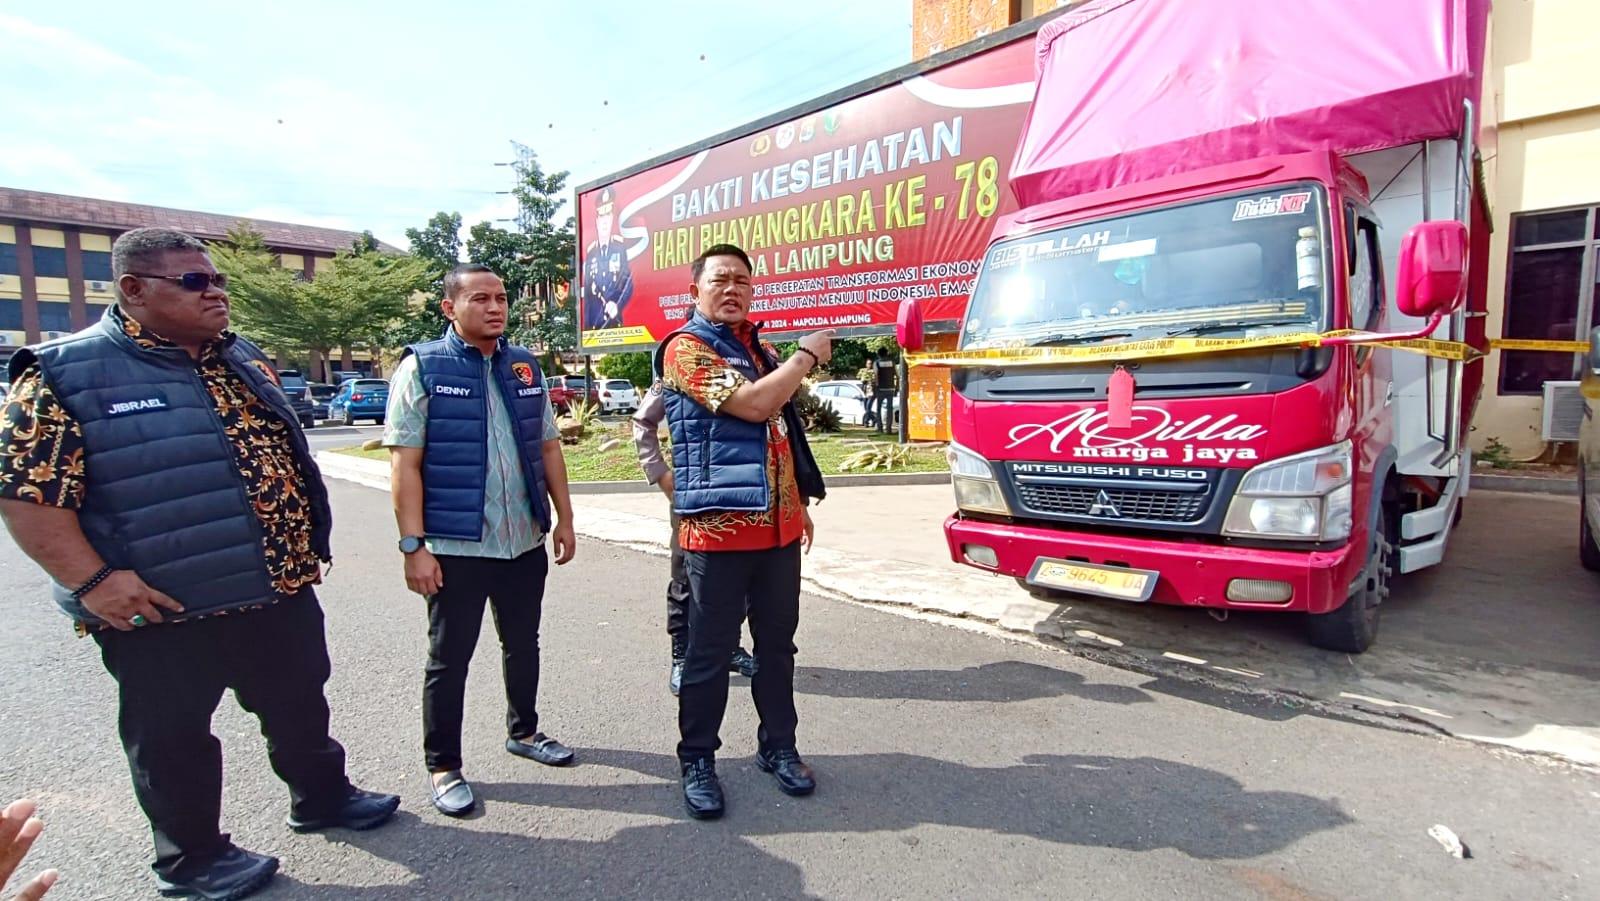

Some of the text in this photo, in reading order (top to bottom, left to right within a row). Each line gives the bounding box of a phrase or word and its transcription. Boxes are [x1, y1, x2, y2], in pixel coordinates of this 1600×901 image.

[671, 116, 963, 223] BAKTI KESEHATAN
[653, 226, 696, 271] HARI
[700, 189, 877, 252] BHAYANGKARA
[885, 174, 927, 230] KE
[955, 156, 999, 220] 78
[774, 235, 894, 275] LAMPUNG
[990, 230, 1111, 264] BISLLAH
[765, 277, 824, 295] PERCEPATAN
[827, 267, 919, 289] TRANSFORMASI
[922, 258, 982, 280] EKONOM
[749, 294, 817, 312] RKELANJUTAN
[819, 289, 864, 307] MENUJU
[867, 283, 938, 303] INDONESIA
[771, 319, 788, 328] 2024
[793, 316, 829, 328] MAPOLDA
[830, 313, 871, 325] LAMPUNG
[436, 385, 471, 397] DENNY
[108, 398, 166, 414] JIBRAEL
[1073, 444, 1258, 463] marga jaya
[1013, 463, 1207, 480] MITSUBISHI FUSO
